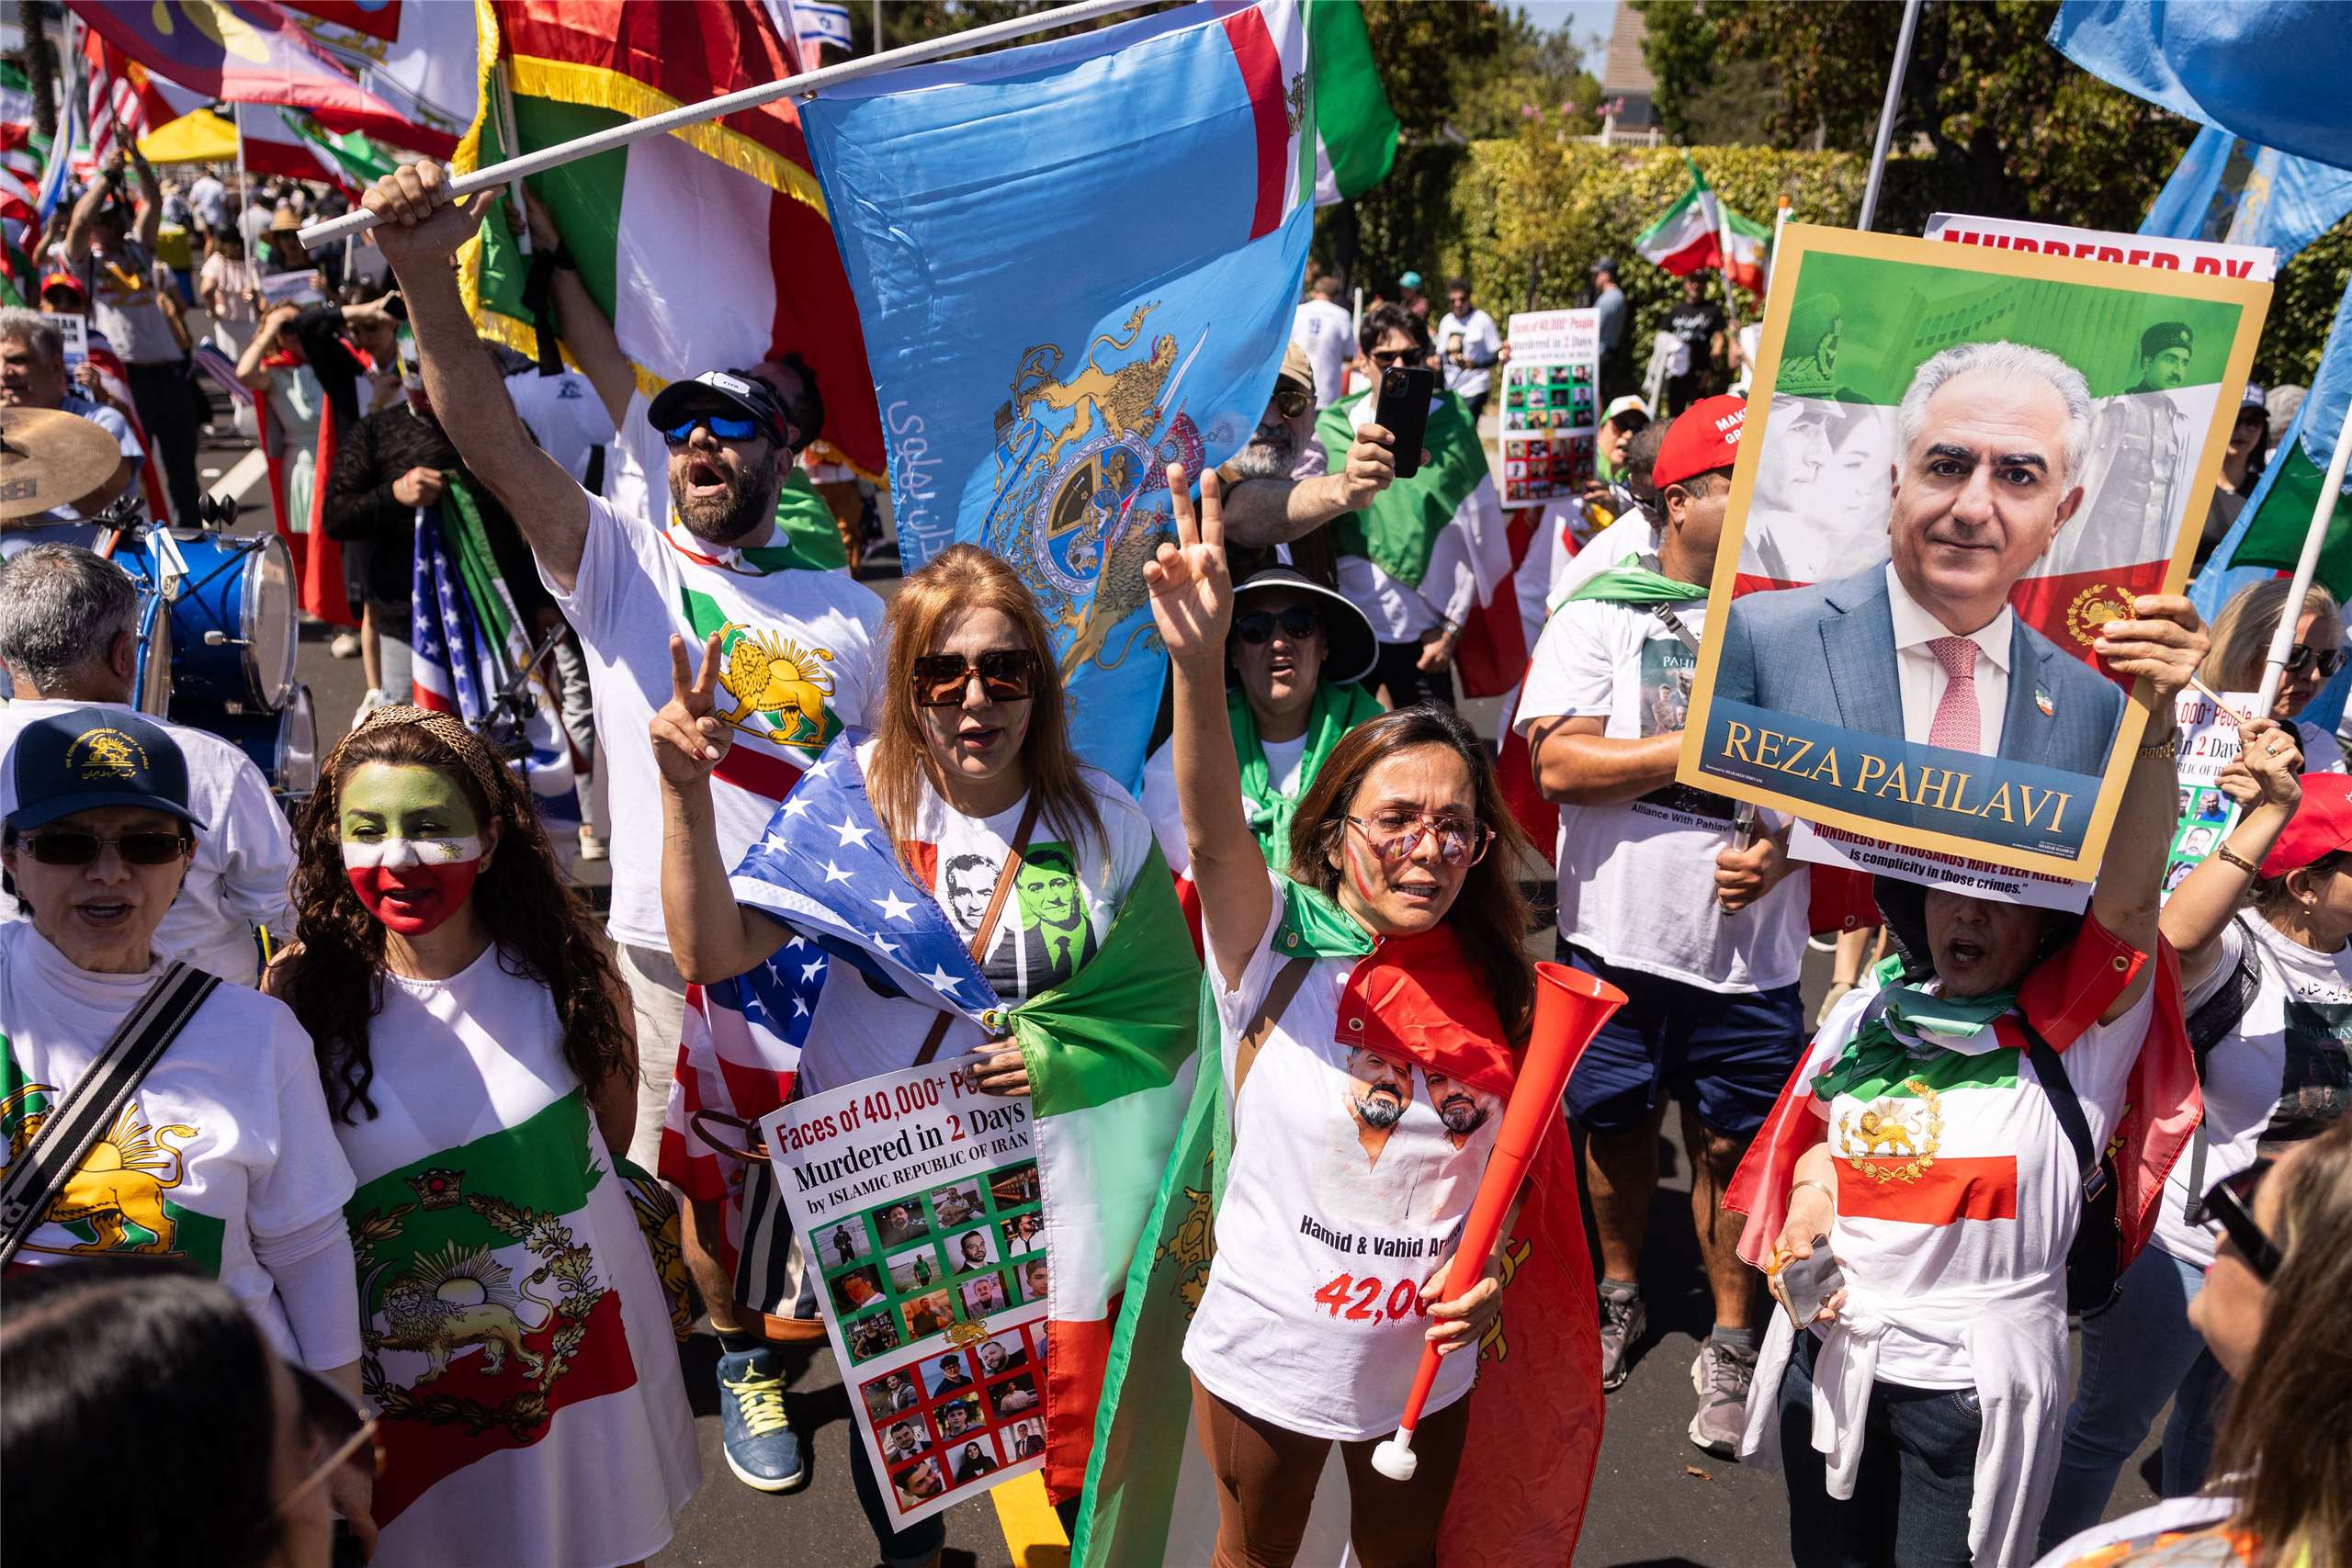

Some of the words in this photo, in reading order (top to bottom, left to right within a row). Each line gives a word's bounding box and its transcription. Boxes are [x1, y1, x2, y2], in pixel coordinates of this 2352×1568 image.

[1724, 427, 1743, 445] GR
[2196, 736, 2207, 756] 2
[1721, 720, 1842, 787] REZA
[1852, 754, 2074, 833] PAHLAVI
[2177, 762, 2198, 774] BLIC
[1631, 803, 1669, 820] Alliance
[1671, 810, 1693, 826] With
[1849, 849, 1860, 861] is
[1862, 852, 1927, 876] complicity
[1927, 865, 1939, 879] in
[1940, 869, 1974, 887] those
[775, 1114, 838, 1155] Faces
[839, 1100, 861, 1133] of
[864, 1077, 946, 1124] 40,000+
[792, 1129, 914, 1192] Murdered
[915, 1123, 944, 1151] in
[946, 1113, 966, 1142] 2
[968, 1101, 1026, 1136] Days
[807, 1198, 827, 1215] by
[828, 1174, 891, 1207] ISLAMIC
[892, 1148, 967, 1183] REPUBLIC
[968, 1145, 989, 1162] OF
[991, 1131, 1030, 1155] IRAN
[1300, 1214, 1352, 1253] Hamid
[1356, 1236, 1368, 1255] &
[1374, 1237, 1424, 1258] Vahid
